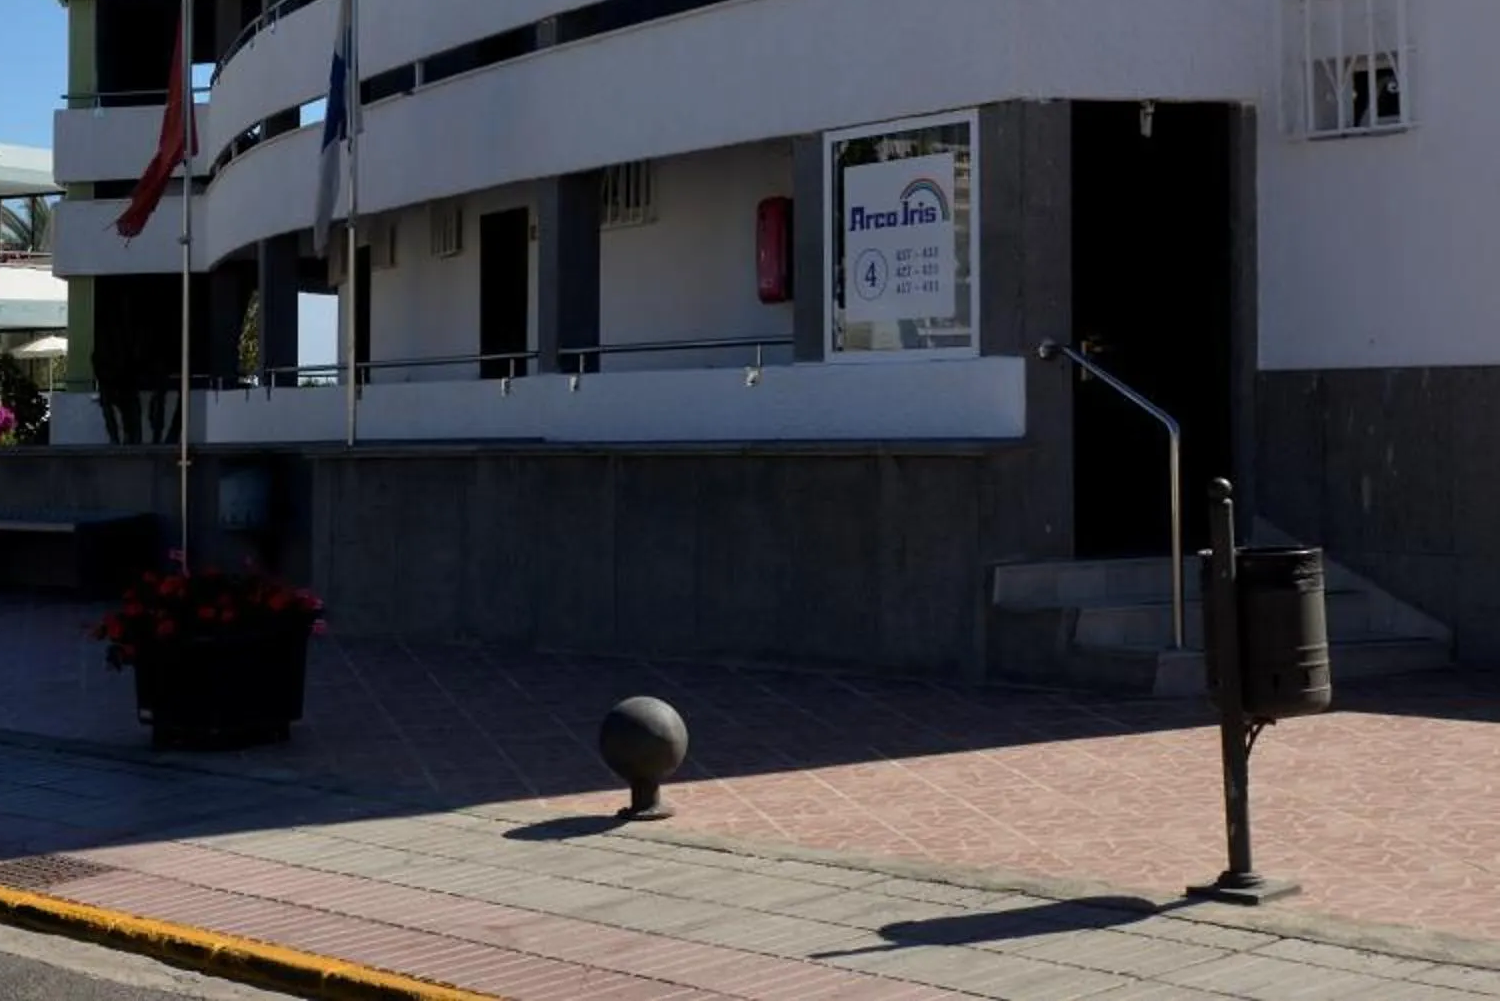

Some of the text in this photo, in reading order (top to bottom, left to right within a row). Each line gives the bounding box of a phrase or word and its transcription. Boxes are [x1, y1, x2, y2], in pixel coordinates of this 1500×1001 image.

[849, 201, 937, 231] Arco Iris
[864, 262, 878, 288] 4
